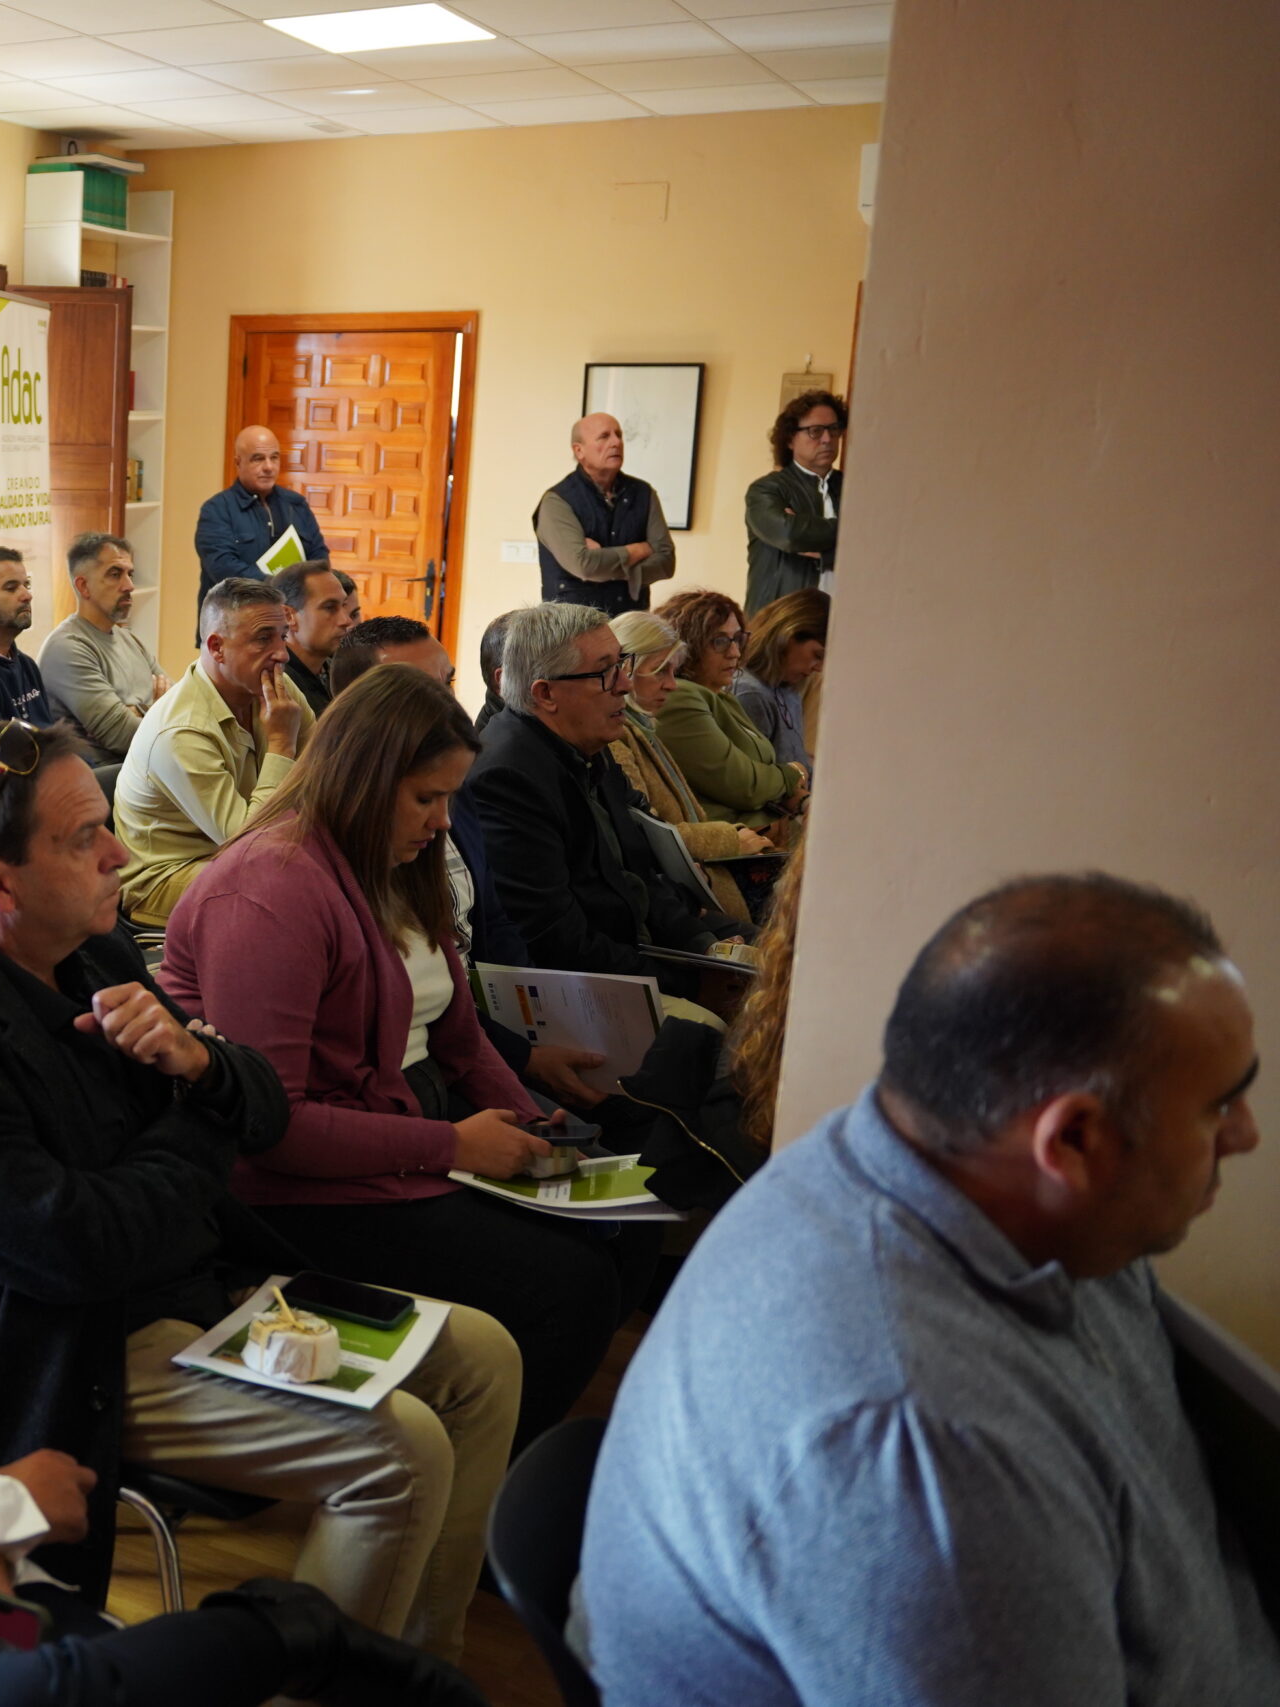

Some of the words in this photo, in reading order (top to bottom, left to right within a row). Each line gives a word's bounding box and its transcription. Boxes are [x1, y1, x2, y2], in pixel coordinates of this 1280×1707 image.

[1, 345, 42, 425] Adac
[25, 494, 34, 507] DE
[0, 513, 26, 529] MUNDO
